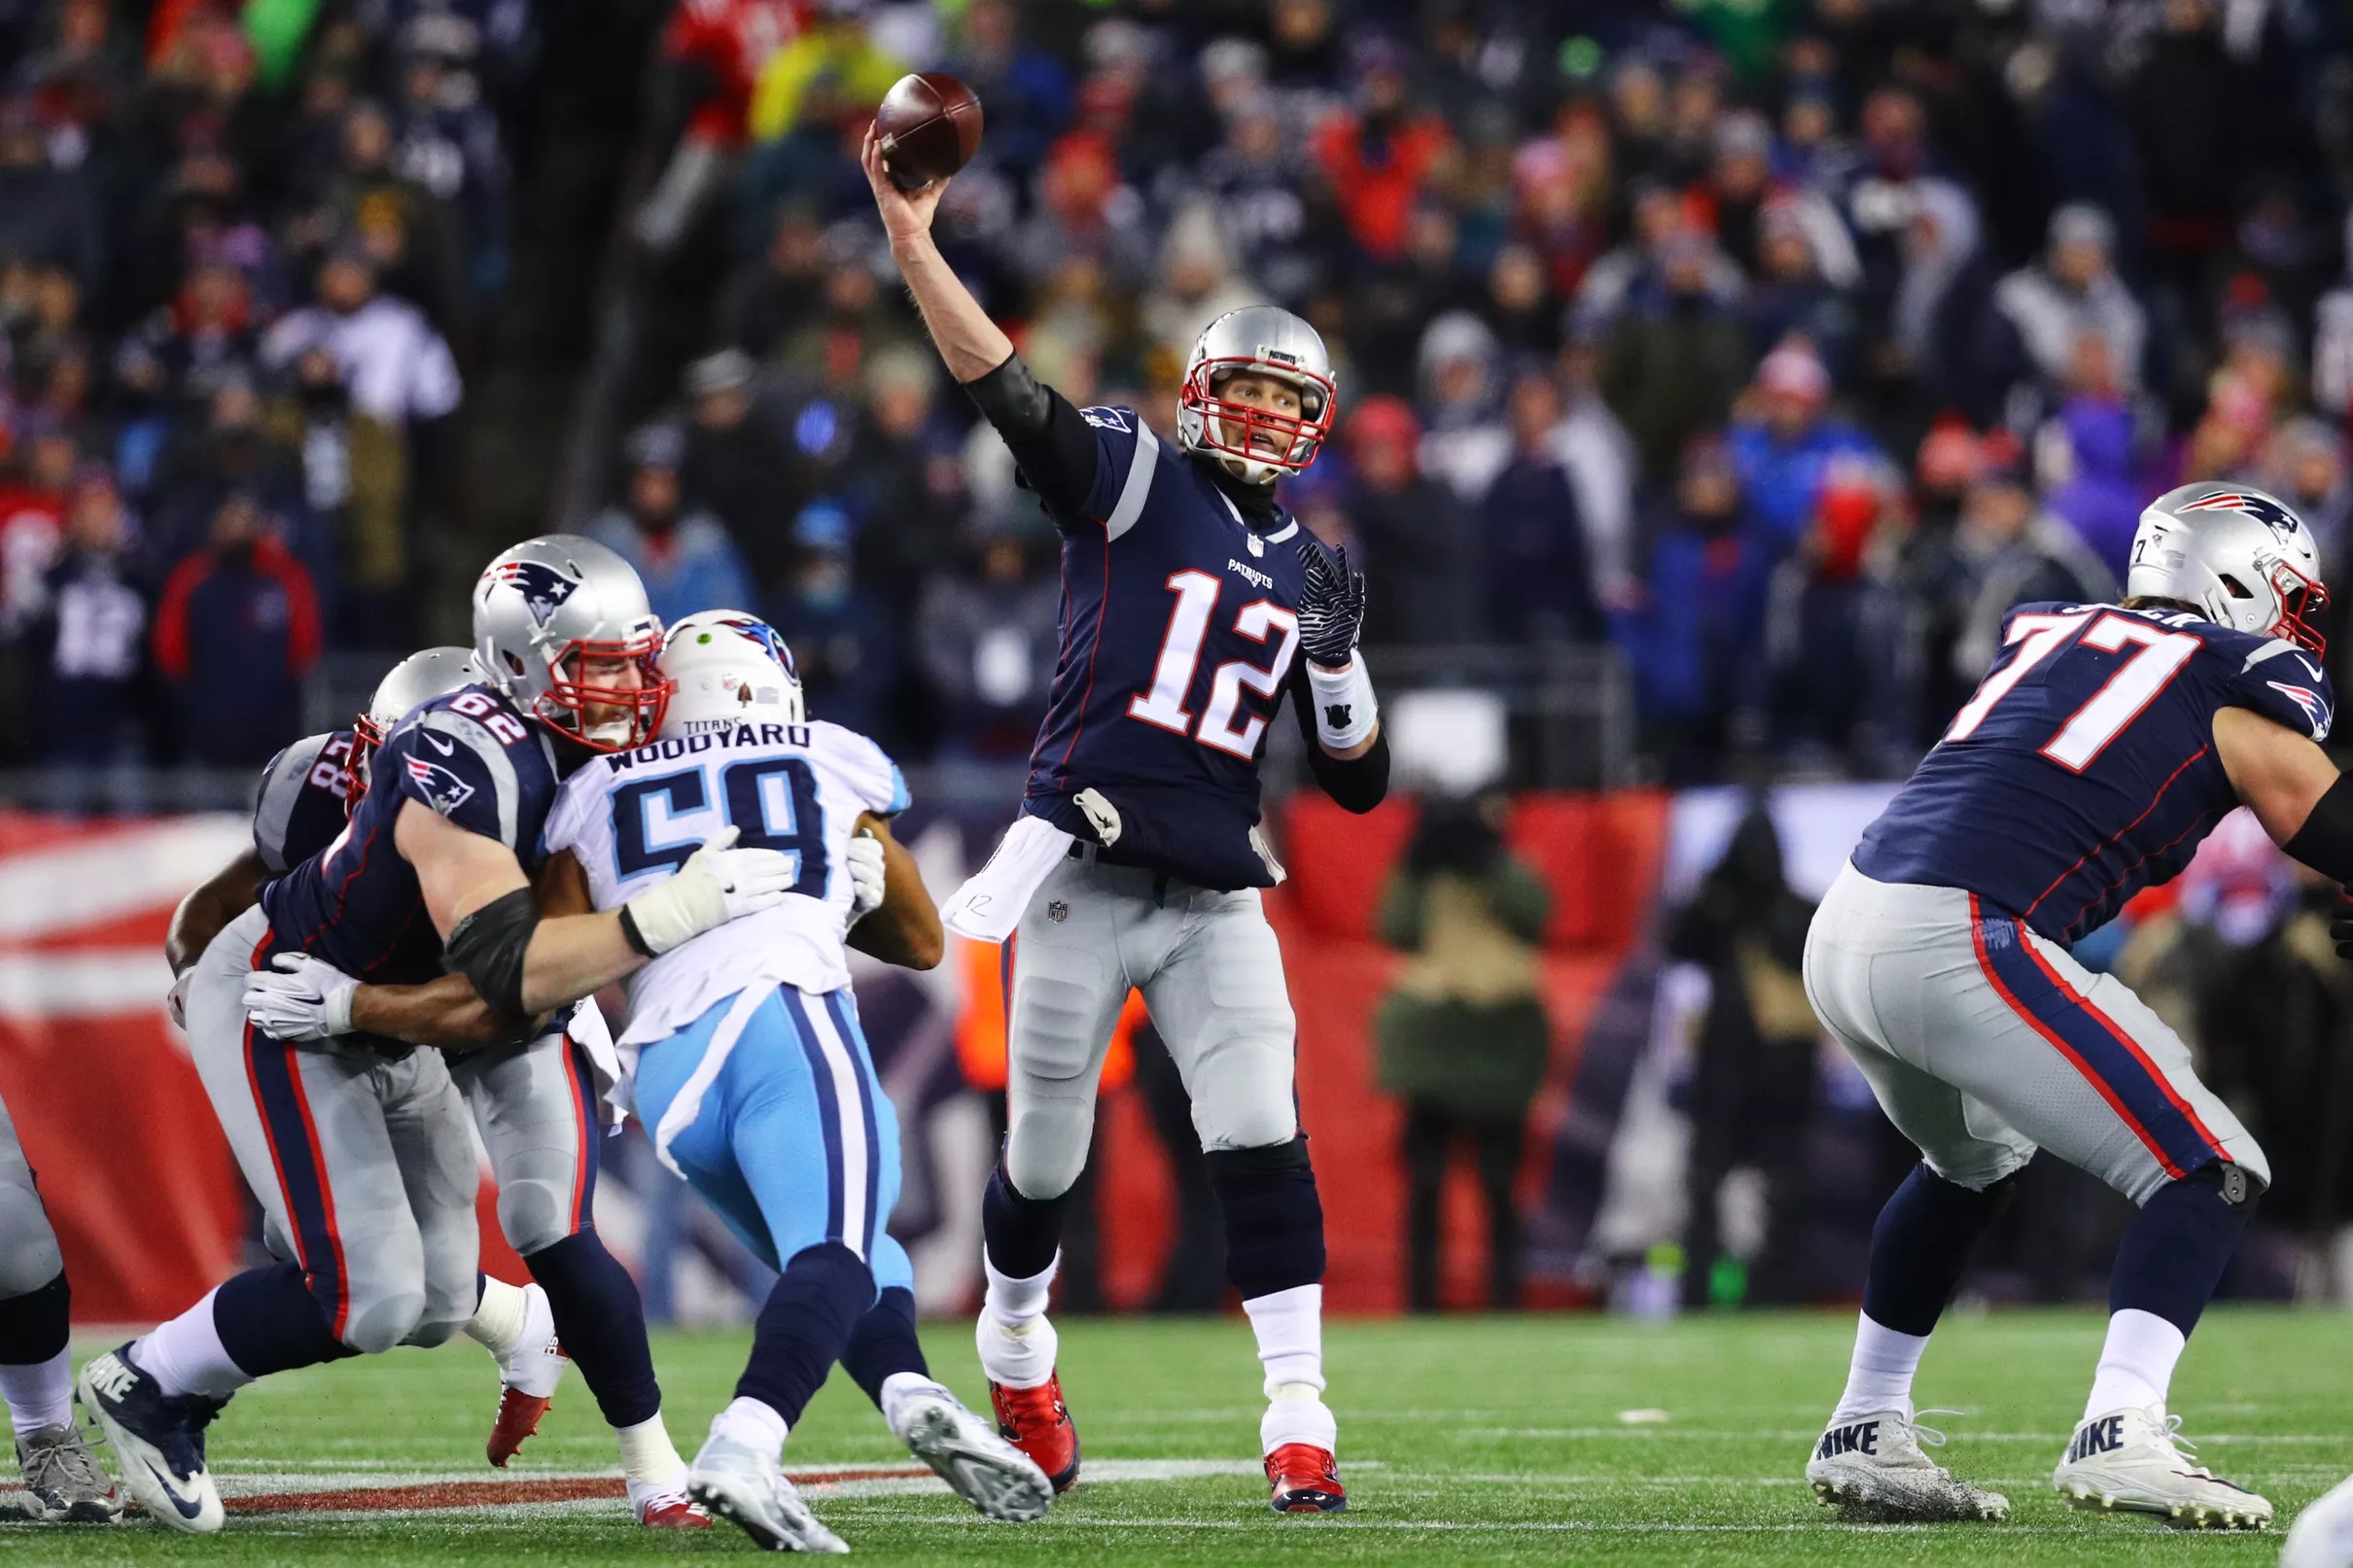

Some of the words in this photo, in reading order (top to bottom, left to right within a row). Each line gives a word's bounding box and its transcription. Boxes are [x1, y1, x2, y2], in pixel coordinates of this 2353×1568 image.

[1227, 558, 1274, 590] PATRIOTS
[1126, 568, 1299, 762] 12
[448, 691, 528, 747] 62
[1943, 610, 2207, 775] 77
[606, 723, 811, 774] WOODYARD
[606, 753, 833, 902] 59
[966, 893, 993, 918] 12
[1815, 1419, 1880, 1461] NIKE
